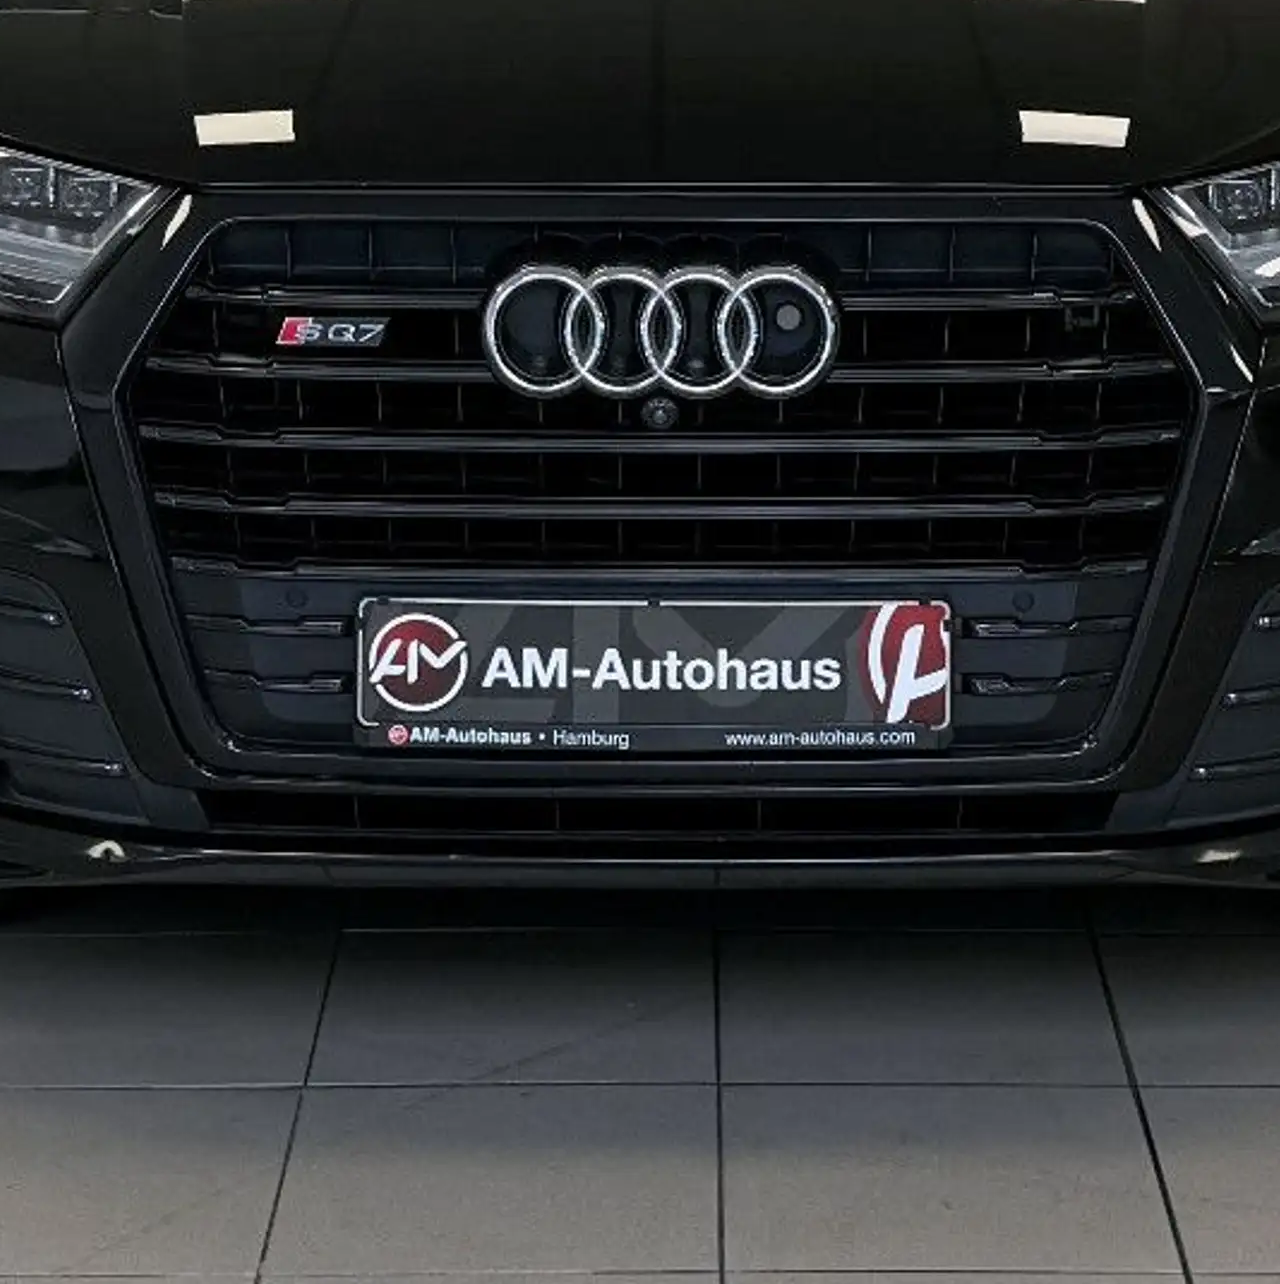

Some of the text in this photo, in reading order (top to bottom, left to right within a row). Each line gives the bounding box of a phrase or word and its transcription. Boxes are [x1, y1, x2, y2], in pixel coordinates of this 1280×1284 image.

[481, 646, 842, 692] AM-Autohaus
[409, 726, 533, 746] AM-Autohaus
[552, 728, 630, 750] Hamburg
[724, 729, 916, 746] www.am-autohaus.com
